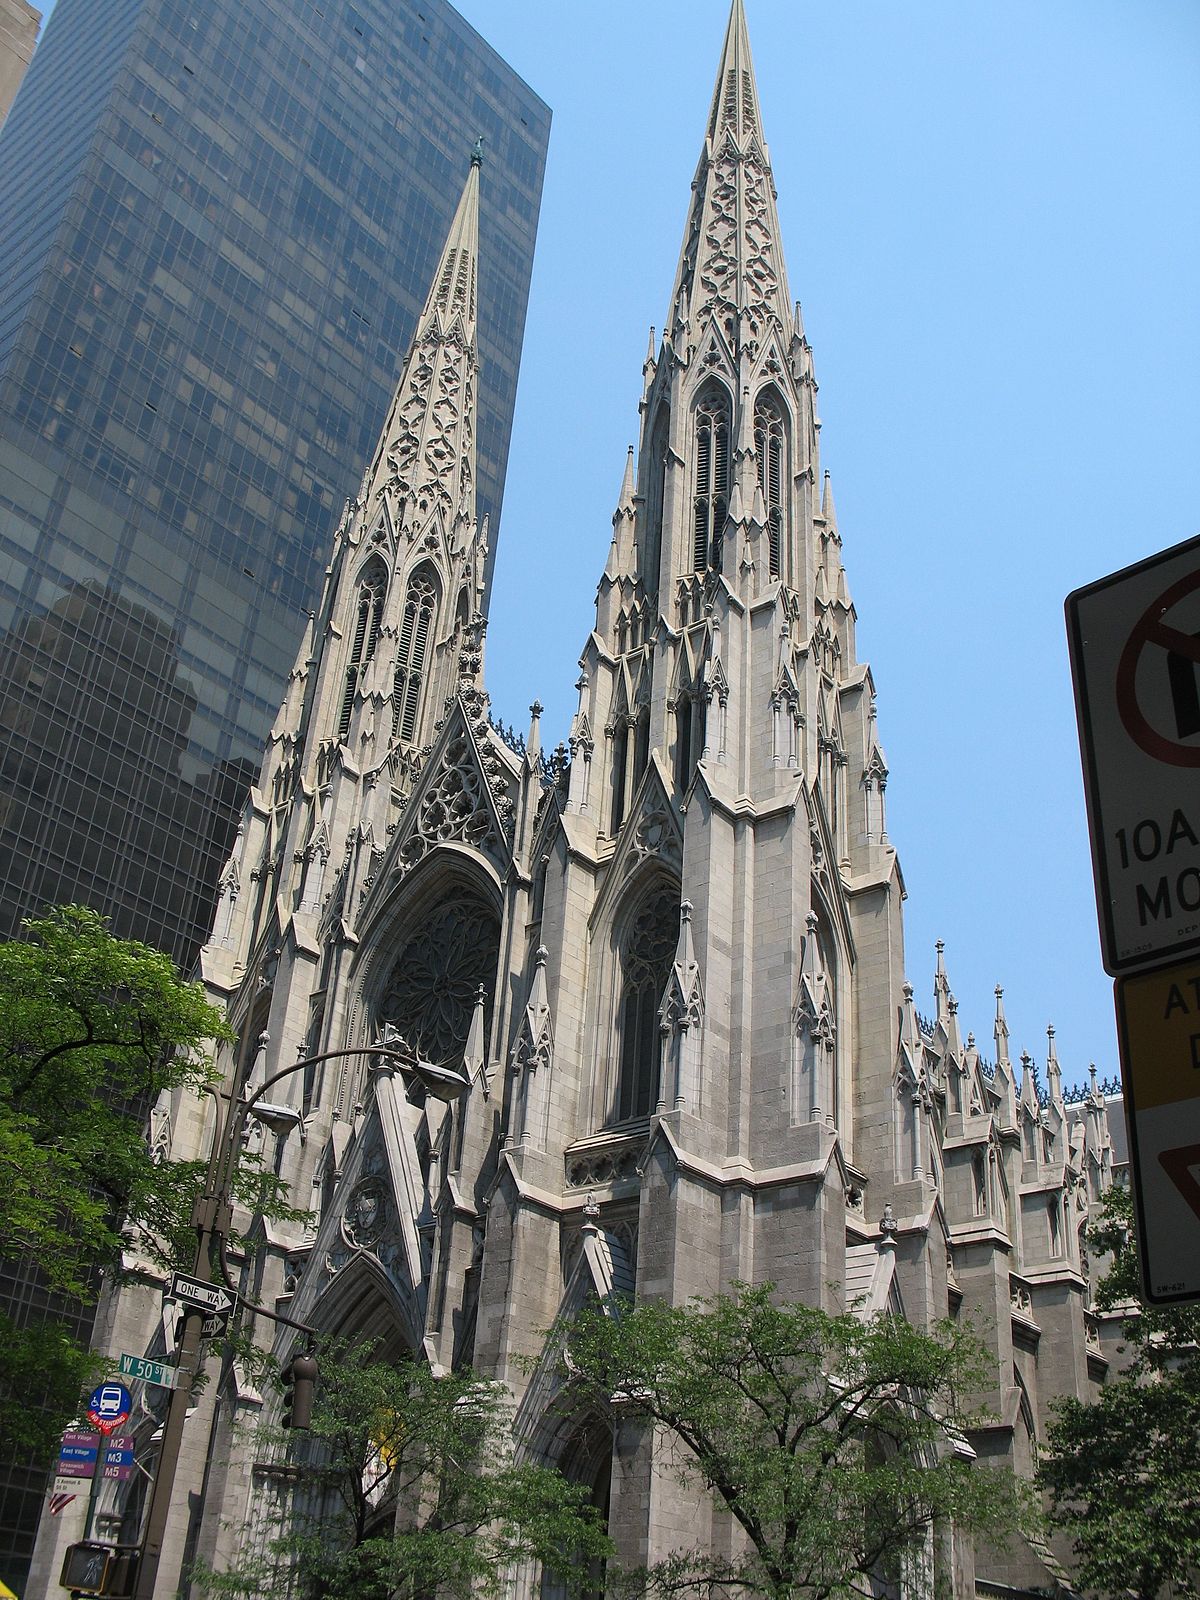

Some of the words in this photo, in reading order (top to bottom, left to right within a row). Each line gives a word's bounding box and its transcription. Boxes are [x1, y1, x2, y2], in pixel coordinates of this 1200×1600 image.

[181, 1283, 200, 1297] ONE
[207, 1291, 226, 1306] WAY
[204, 1320, 220, 1332] WAY
[123, 1356, 133, 1373] W
[136, 1361, 153, 1379] 50
[154, 1366, 163, 1376] ST
[90, 1413, 99, 1422] NO
[98, 1415, 126, 1427] STANDING
[110, 1438, 125, 1449] M2
[62, 1447, 74, 1455] East
[74, 1448, 90, 1457] Village
[107, 1452, 122, 1463] M3
[104, 1466, 120, 1477] M5
